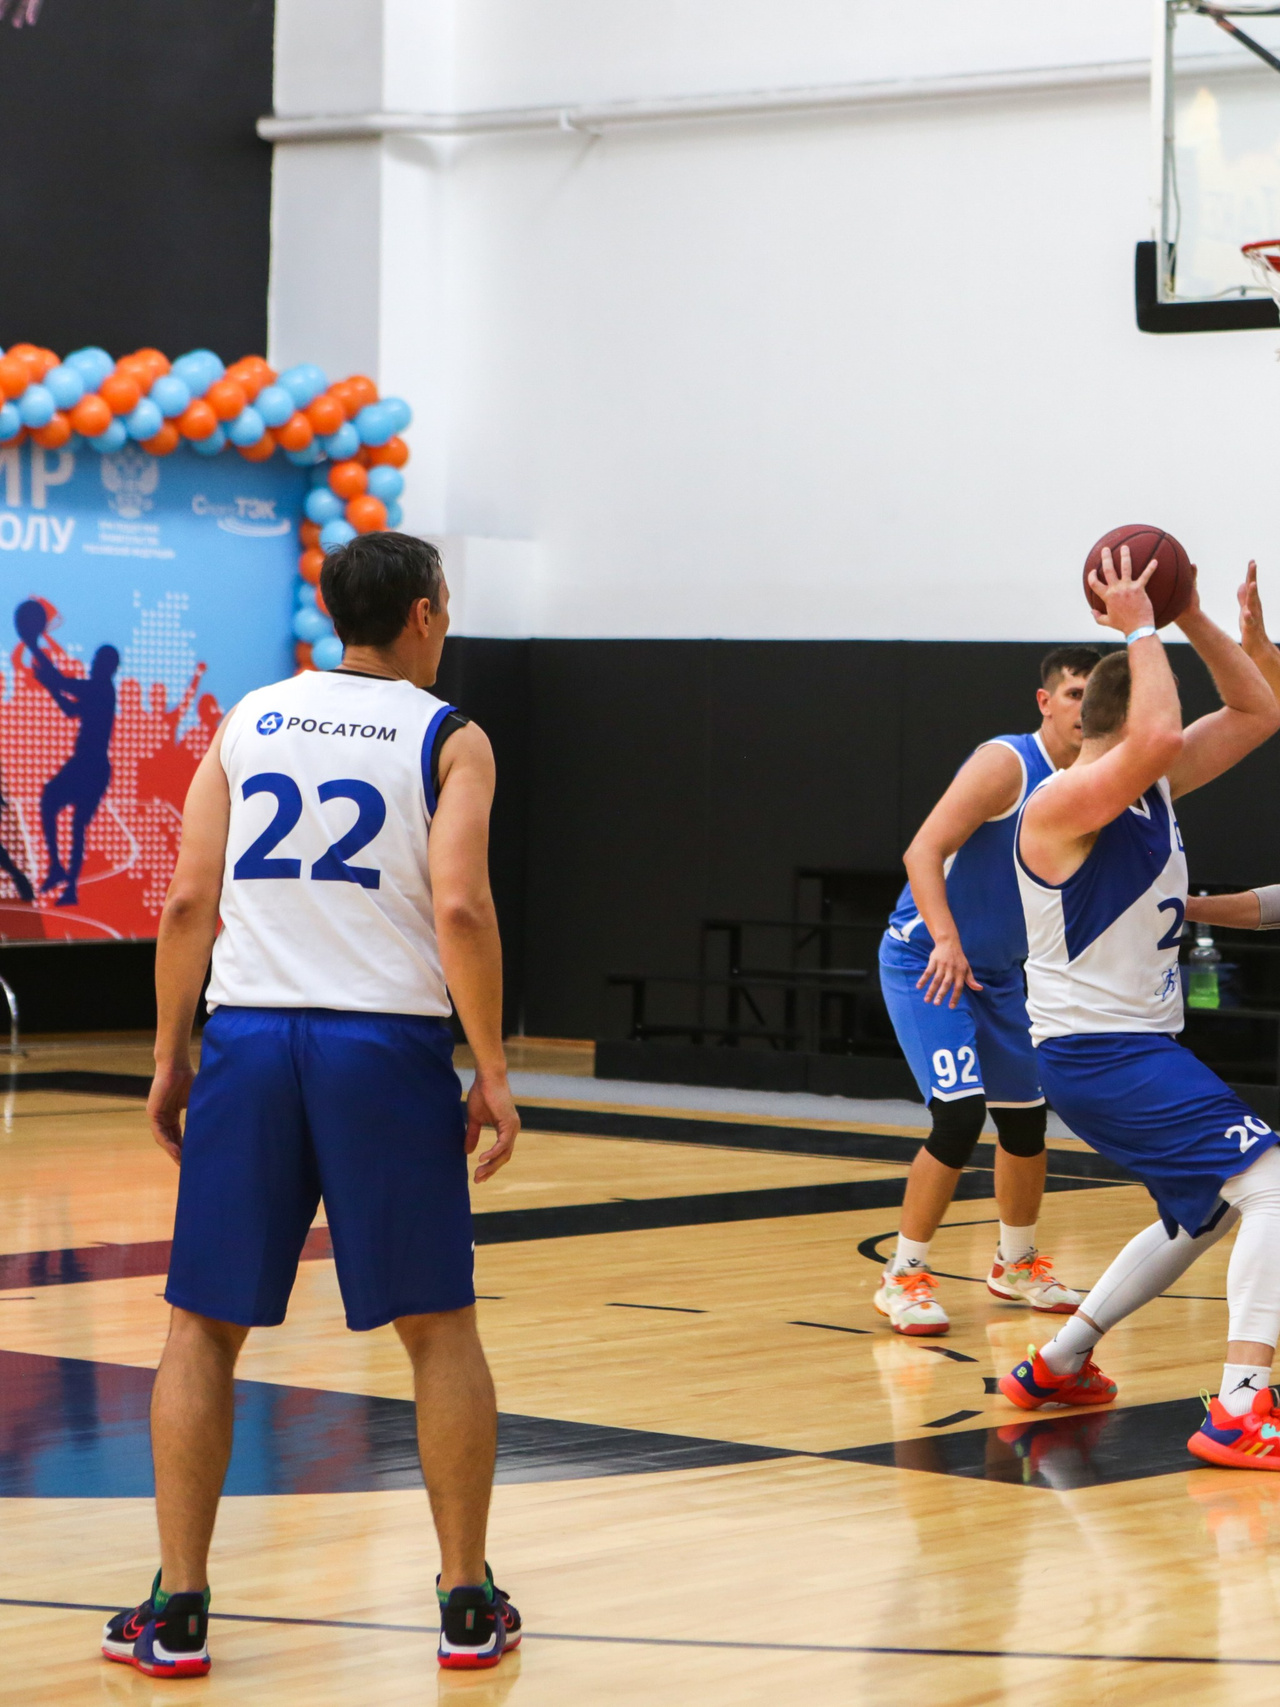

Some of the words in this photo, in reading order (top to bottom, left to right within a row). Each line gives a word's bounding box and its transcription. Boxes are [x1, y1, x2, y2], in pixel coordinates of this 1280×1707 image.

[0, 513, 75, 554] ОЛУ
[286, 716, 398, 743] РОСАТОМ
[233, 772, 387, 890] 22
[932, 1045, 979, 1089] 92
[1224, 1115, 1272, 1154] 20
